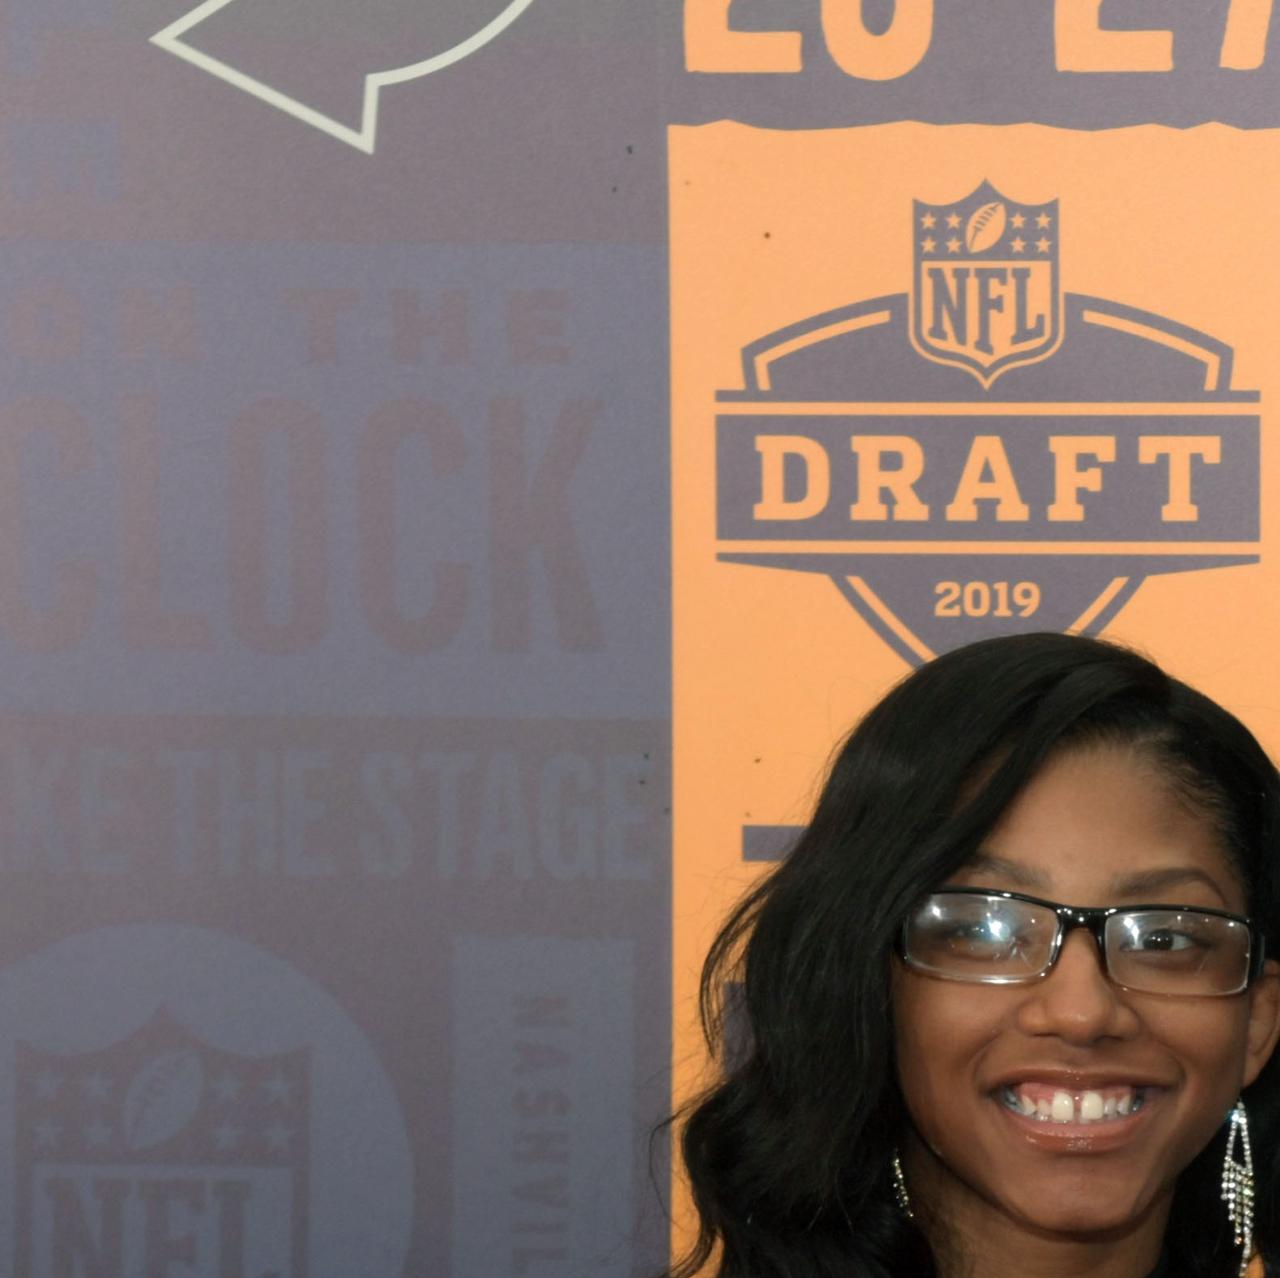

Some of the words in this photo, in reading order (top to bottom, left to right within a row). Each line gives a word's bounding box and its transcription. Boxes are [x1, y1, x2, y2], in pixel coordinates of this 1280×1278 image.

[927, 266, 1046, 359] NFL
[0, 392, 607, 655] CLOCK
[752, 434, 1222, 523] DRAFT
[932, 579, 1043, 619] 2019
[157, 746, 338, 877] THE
[358, 750, 656, 881] STAGE
